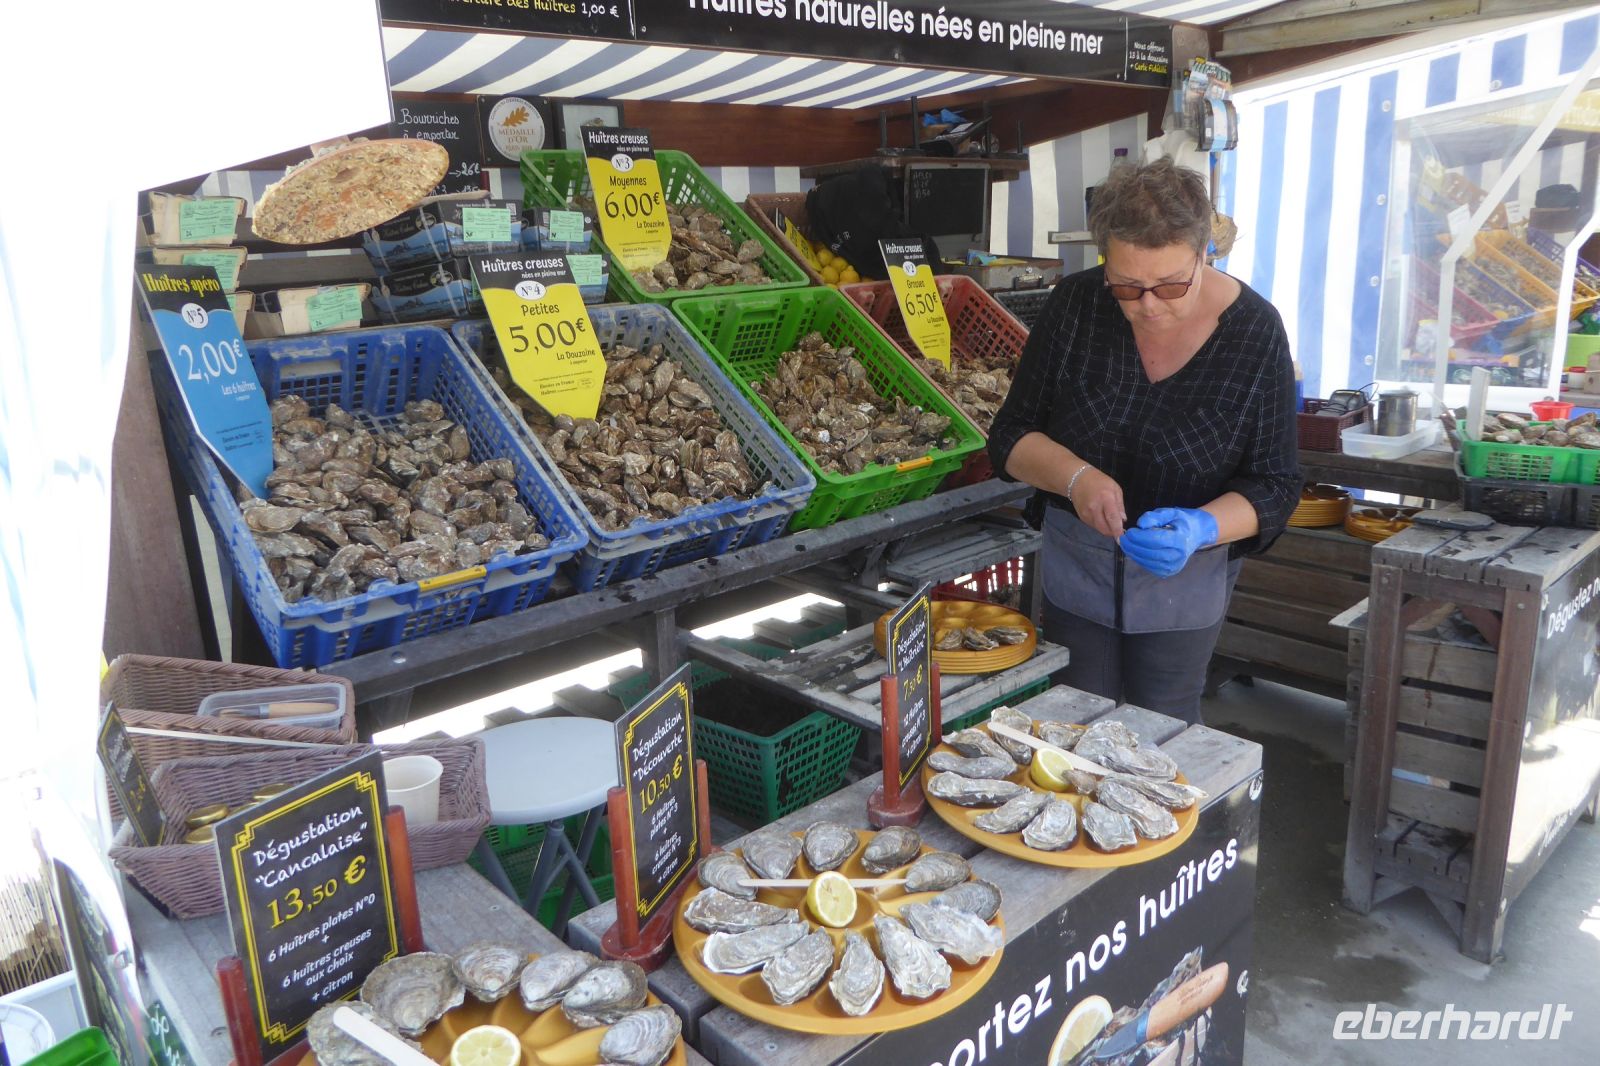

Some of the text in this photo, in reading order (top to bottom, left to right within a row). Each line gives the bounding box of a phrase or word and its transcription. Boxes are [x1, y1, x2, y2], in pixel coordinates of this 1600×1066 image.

[582, 2, 606, 18] 1,00
[610, 6, 620, 18] €
[795, 0, 915, 34] naturelles
[921, 7, 973, 41] nées
[978, 20, 1004, 44] en
[1010, 20, 1066, 51] pleine
[1070, 32, 1104, 54] mer
[398, 108, 460, 124] Bourriches
[588, 131, 648, 144] Huîtres creuses
[610, 176, 647, 190] Moyennes
[885, 242, 922, 254] Huîtres creuses
[481, 257, 563, 273] Huîtres creuses
[541, 270, 556, 278] pleine
[143, 272, 220, 297] Huîtres apéro
[521, 303, 560, 316] Petites
[557, 349, 596, 360] La Douzaine
[1547, 584, 1592, 640] Dégustez
[633, 712, 682, 762] Dégustation
[640, 754, 682, 814] 10,50 €
[650, 816, 666, 840] plates
[651, 814, 656, 825] 6
[253, 806, 363, 867] Dégustation
[652, 849, 672, 875] creuses
[655, 850, 659, 861] 6
[662, 857, 678, 879] citron
[267, 855, 366, 929] 13,50 €
[268, 949, 277, 963] 6
[279, 926, 320, 957] Huîtres
[322, 906, 354, 934] plates
[322, 935, 329, 944] +
[283, 928, 372, 988] 6 huîtres creuses
[930, 838, 1238, 1066] ortez nos huîtres
[306, 952, 354, 986] aux choix
[312, 970, 354, 1002] + citron
